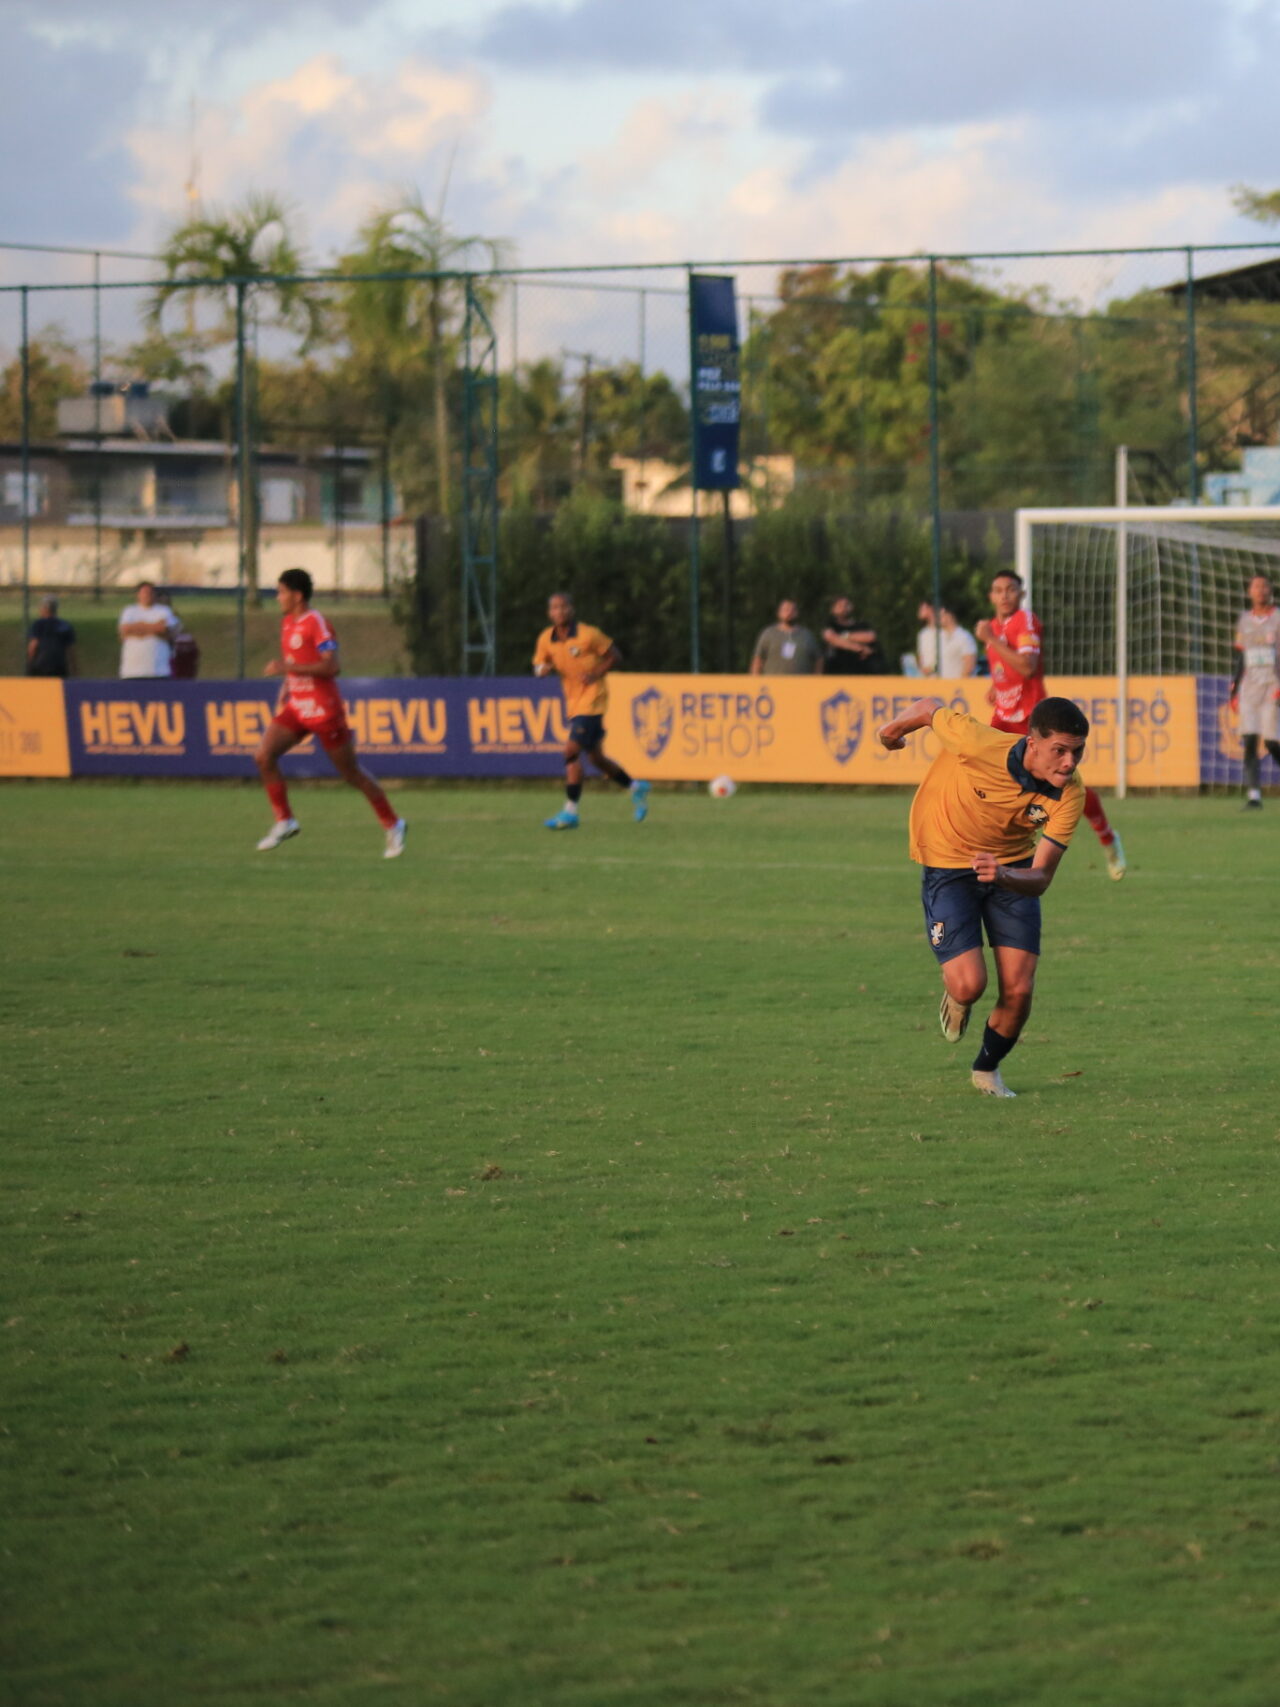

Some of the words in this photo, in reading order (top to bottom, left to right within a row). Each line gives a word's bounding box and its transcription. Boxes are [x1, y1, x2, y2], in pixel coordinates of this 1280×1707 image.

[680, 685, 775, 720] RETRÔ
[872, 687, 970, 722] REÔ
[80, 701, 186, 747] HEVU
[344, 698, 447, 745] HEVU
[468, 698, 571, 745] HEVU
[681, 724, 775, 758] SHOP
[1081, 728, 1171, 765] HOP
